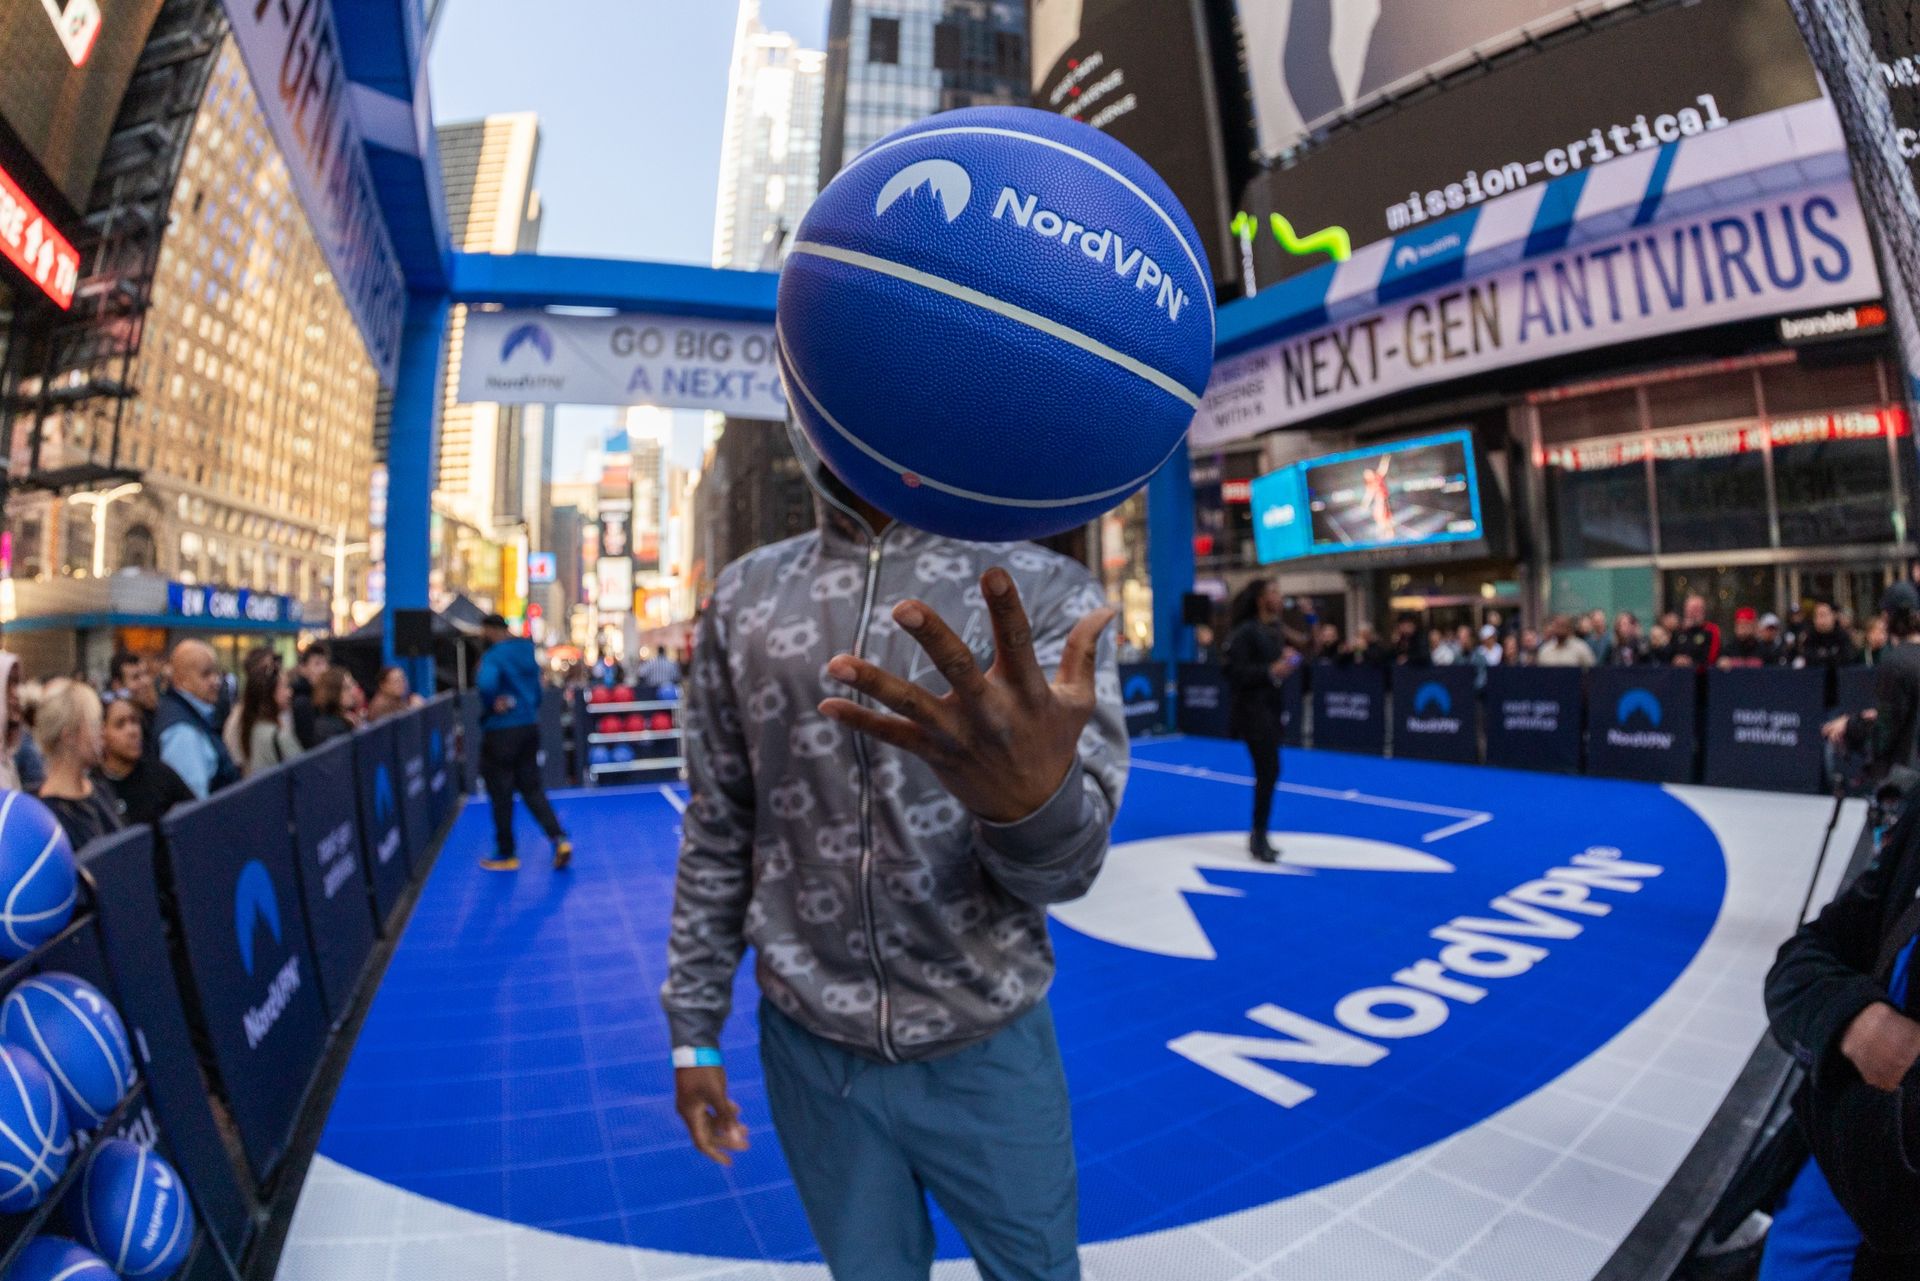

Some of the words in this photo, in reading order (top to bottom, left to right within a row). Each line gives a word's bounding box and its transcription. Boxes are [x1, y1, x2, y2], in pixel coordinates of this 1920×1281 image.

[1385, 93, 1730, 232] mission-critical
[610, 325, 665, 358] GO
[675, 328, 732, 362] BIG
[1281, 279, 1503, 410] NEXT-GEN
[1518, 195, 1853, 343] ANTIVIRUS
[625, 364, 653, 395] A
[1166, 847, 1665, 1109] NordVPN
